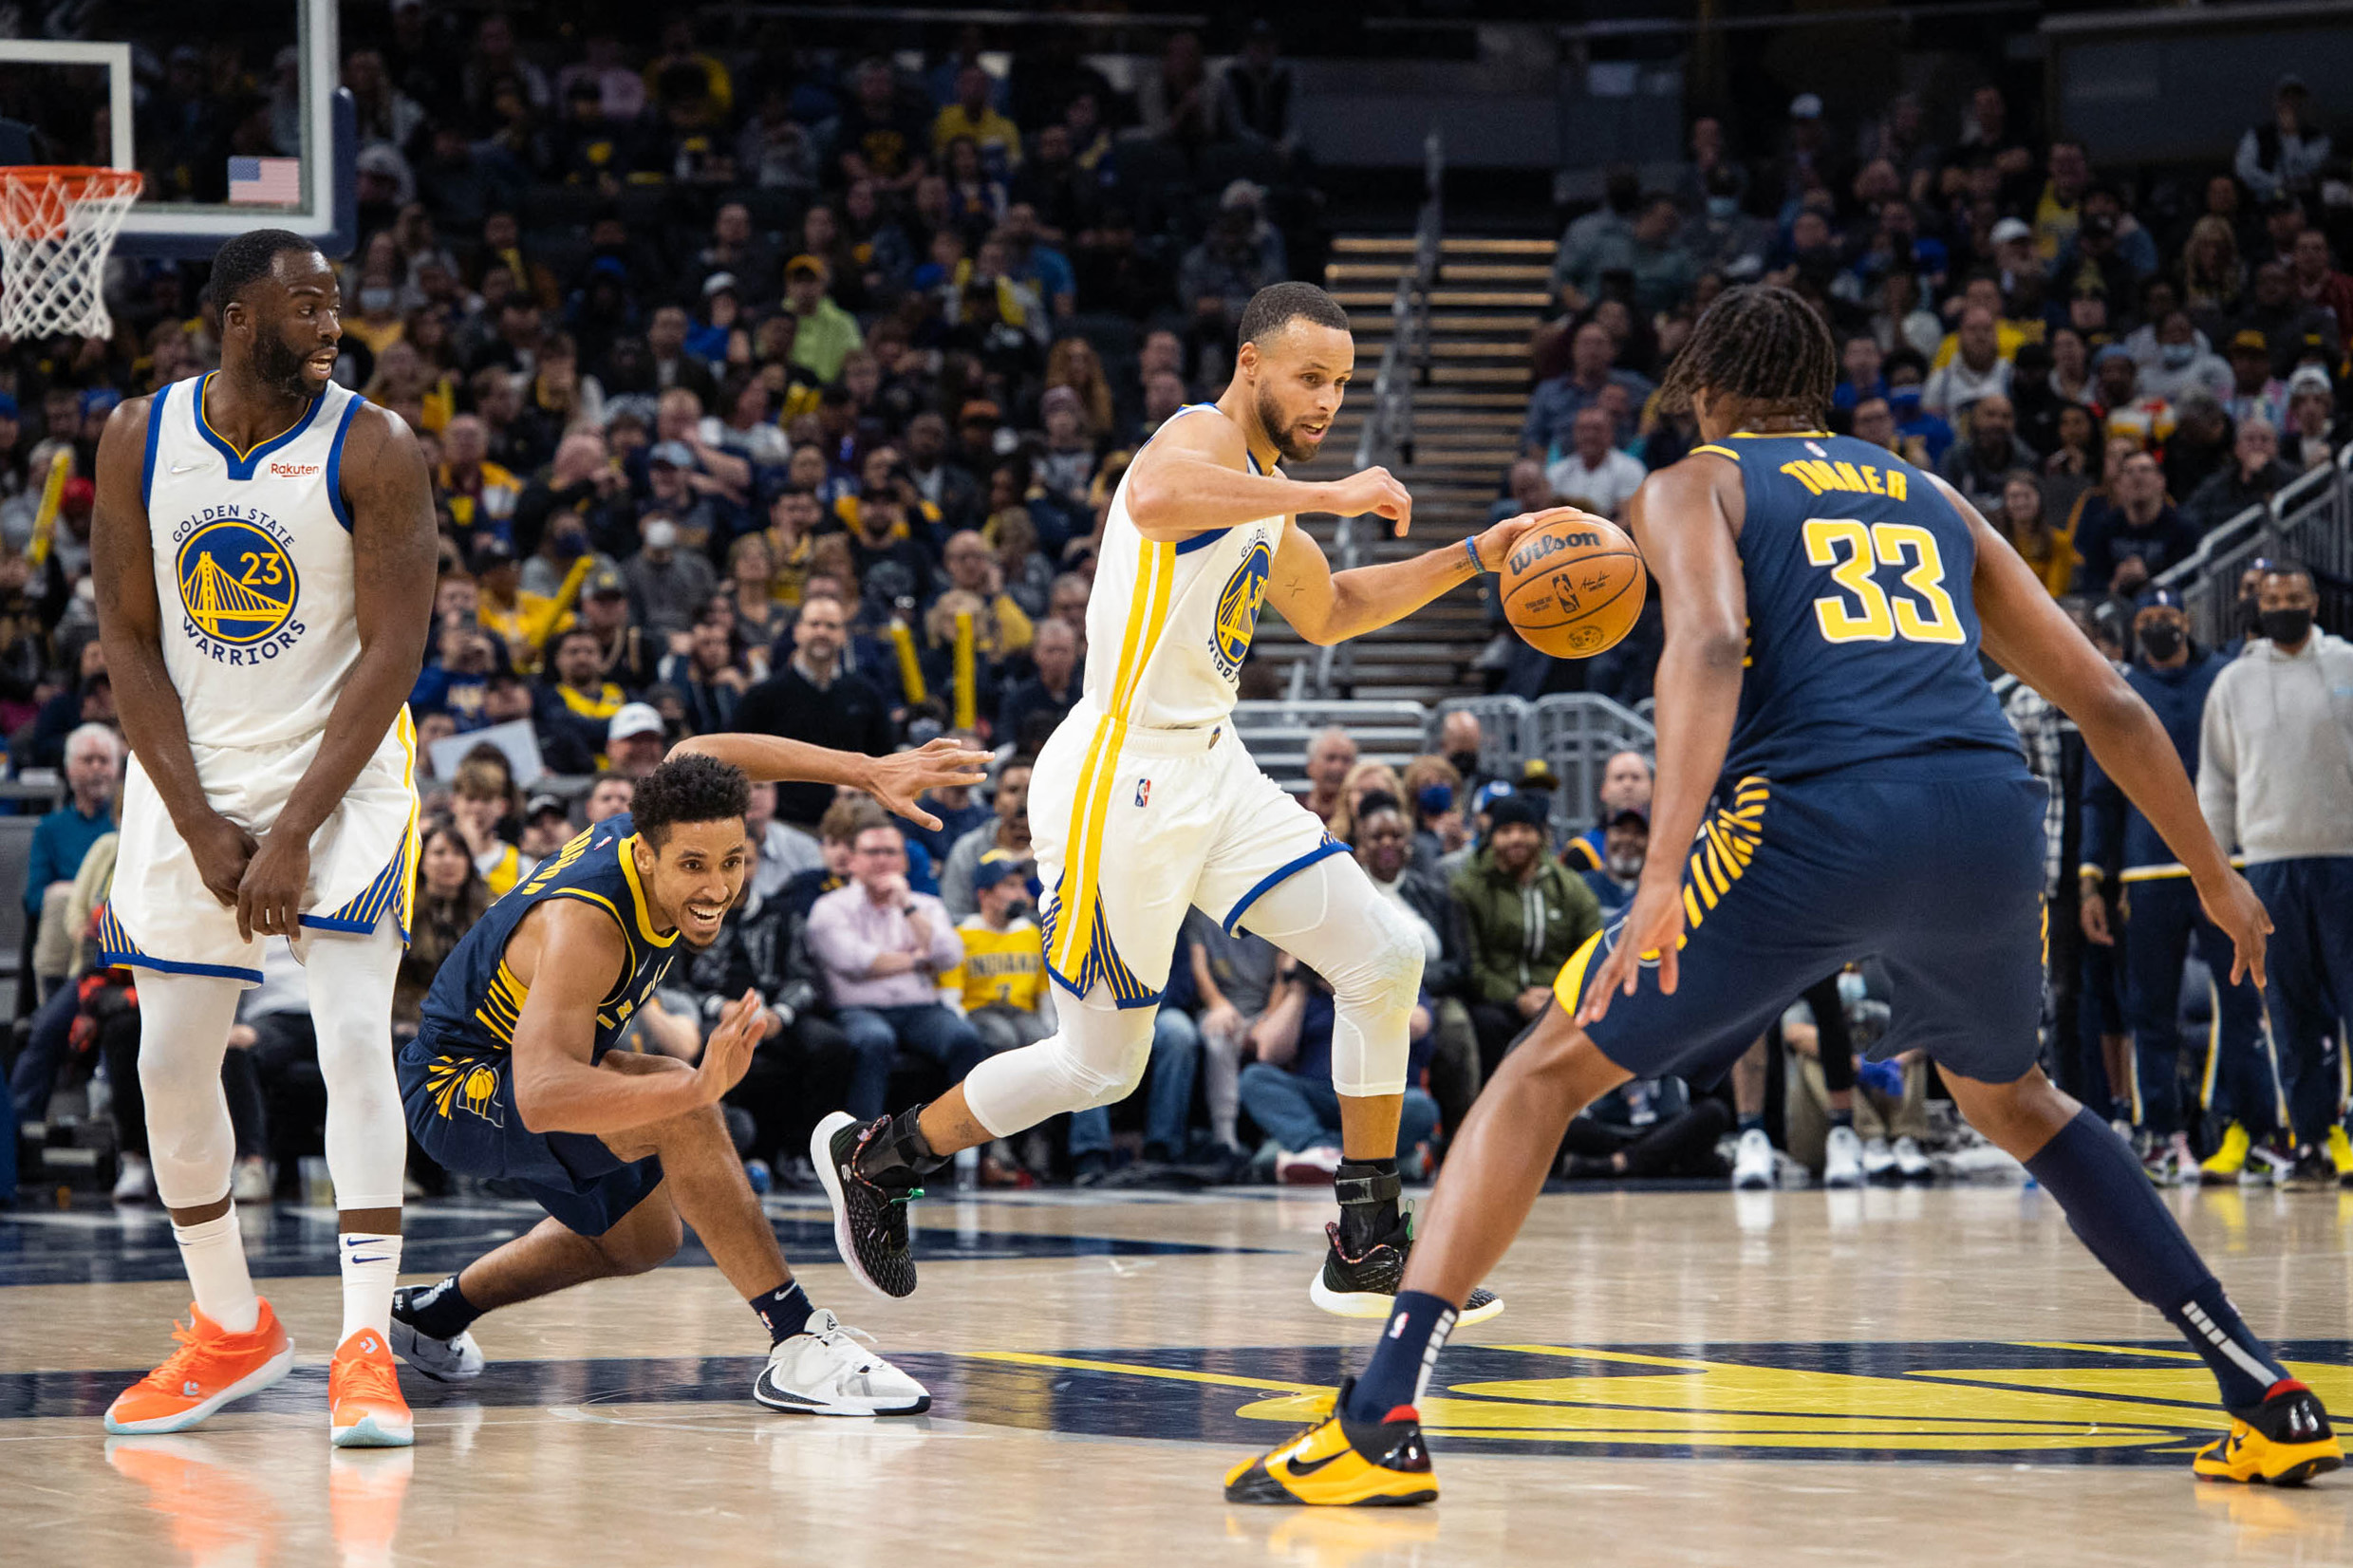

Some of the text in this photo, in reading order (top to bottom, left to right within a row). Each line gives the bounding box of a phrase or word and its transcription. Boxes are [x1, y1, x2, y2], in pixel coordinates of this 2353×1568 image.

[271, 463, 319, 476] Rakuten
[173, 504, 295, 548] GOLDEN STATE
[240, 551, 283, 586] 23
[1509, 532, 1601, 576] Wilson
[1249, 574, 1268, 610] 30
[1802, 518, 1967, 644] 33
[183, 615, 307, 666] WARRIORS
